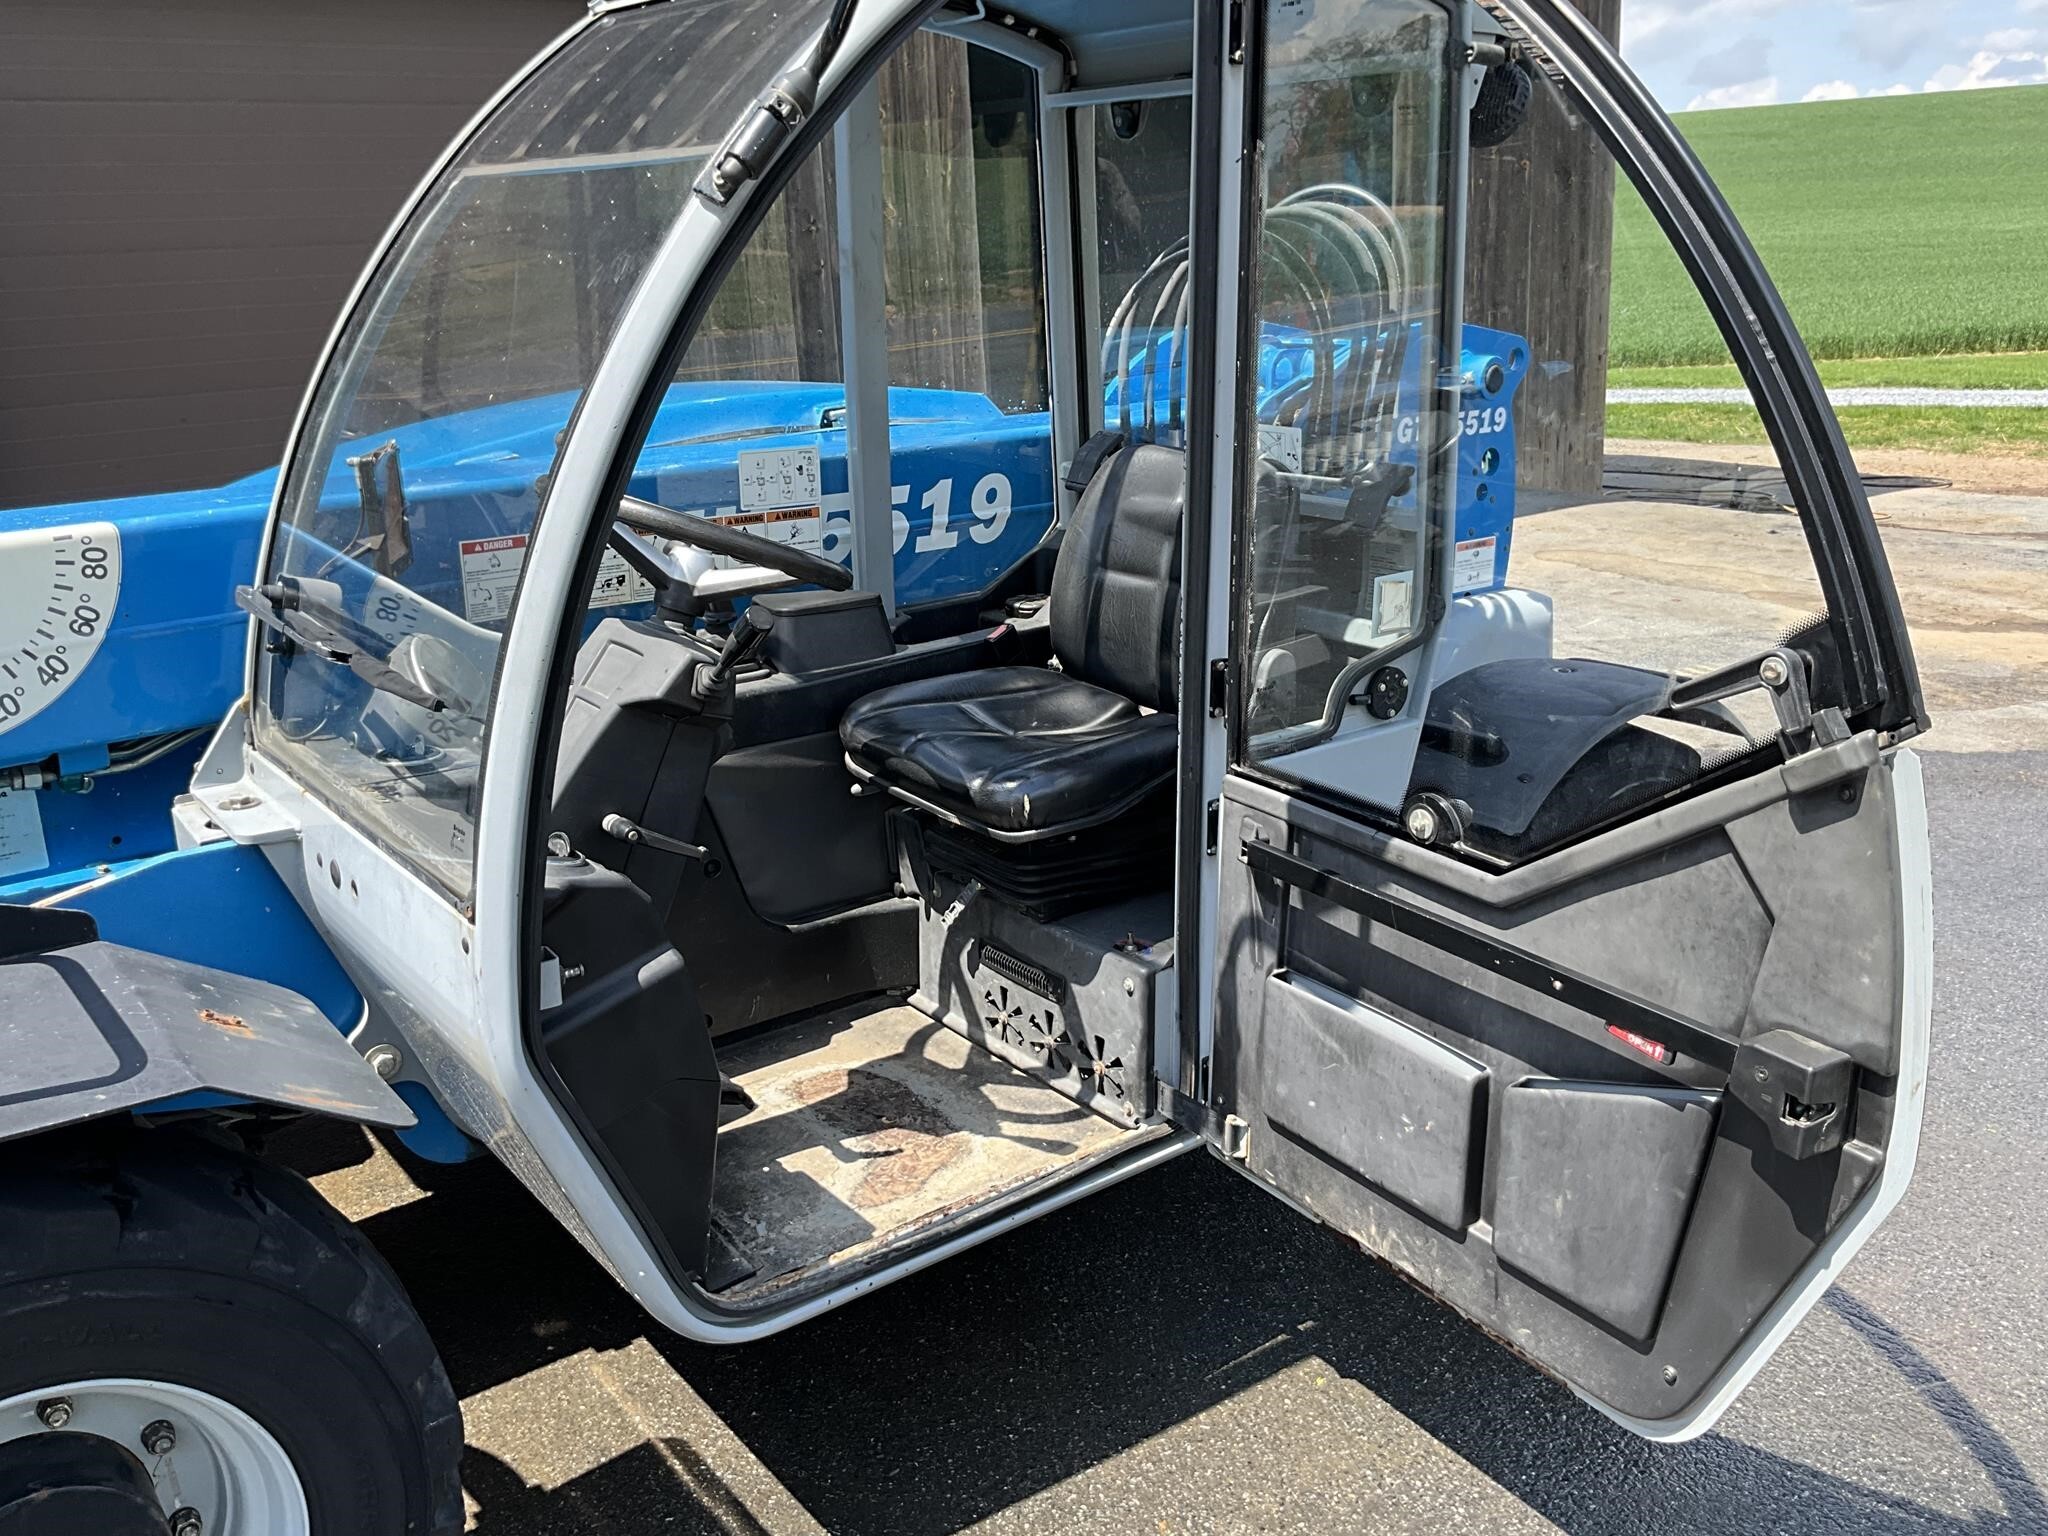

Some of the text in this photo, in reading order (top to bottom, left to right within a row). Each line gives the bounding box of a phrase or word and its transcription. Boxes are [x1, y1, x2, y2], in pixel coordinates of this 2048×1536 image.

[733, 513, 764, 525] WARNING
[781, 508, 813, 520] WARNING
[483, 539, 514, 551] DANGER
